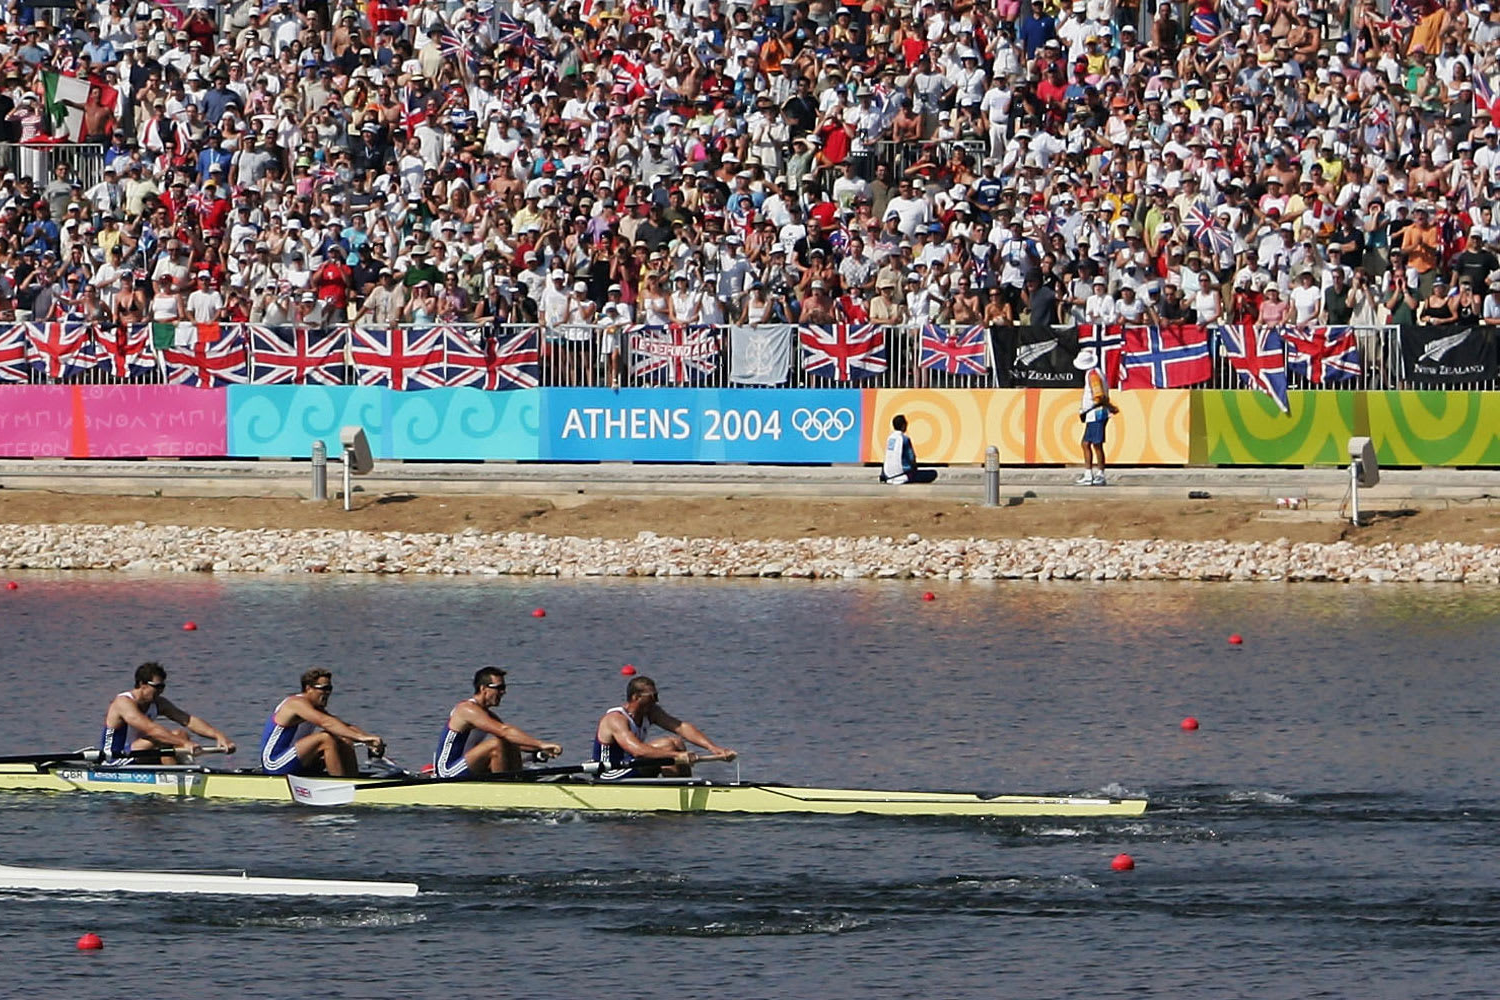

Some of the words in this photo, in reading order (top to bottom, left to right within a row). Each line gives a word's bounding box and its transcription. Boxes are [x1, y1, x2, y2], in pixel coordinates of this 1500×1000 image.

[561, 408, 691, 439] ATHENS
[703, 409, 782, 441] 2004
[62, 770, 83, 779] GBR
